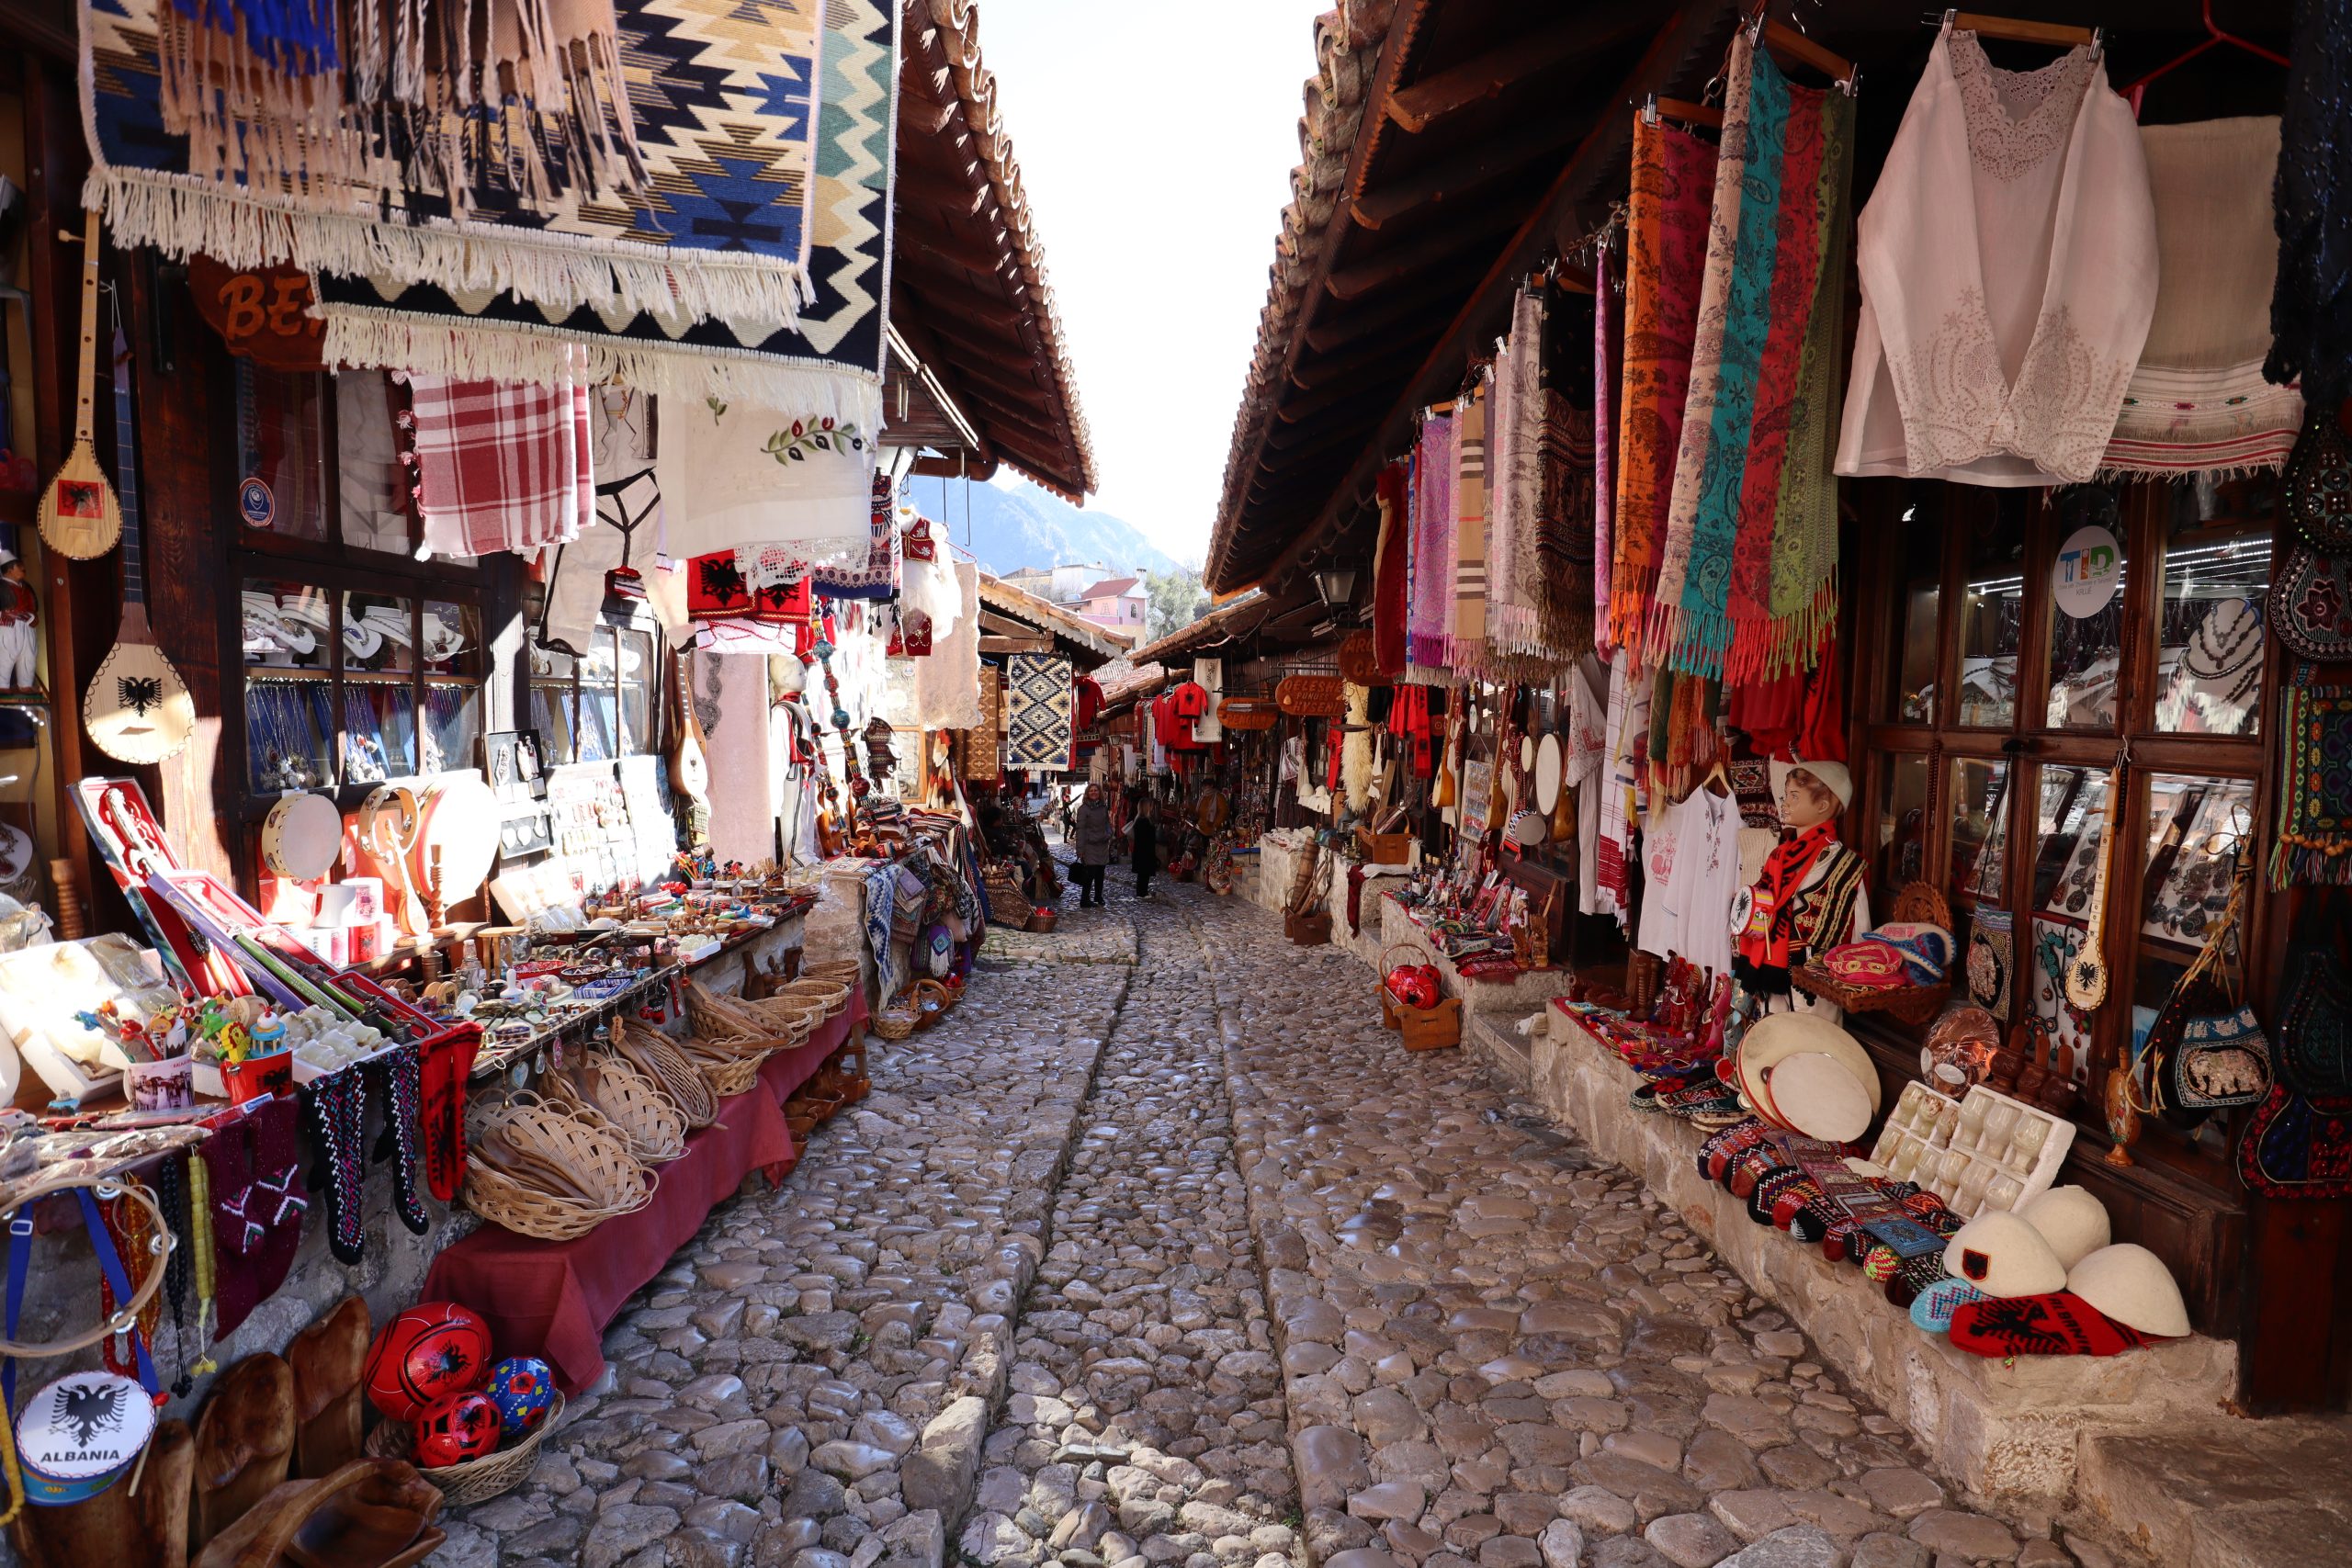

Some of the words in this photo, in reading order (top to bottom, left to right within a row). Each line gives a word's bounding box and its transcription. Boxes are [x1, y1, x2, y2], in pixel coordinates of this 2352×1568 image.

[218, 275, 322, 341] BE
[2060, 546, 2114, 582] TID
[40, 1450, 120, 1462] ALBANIA
